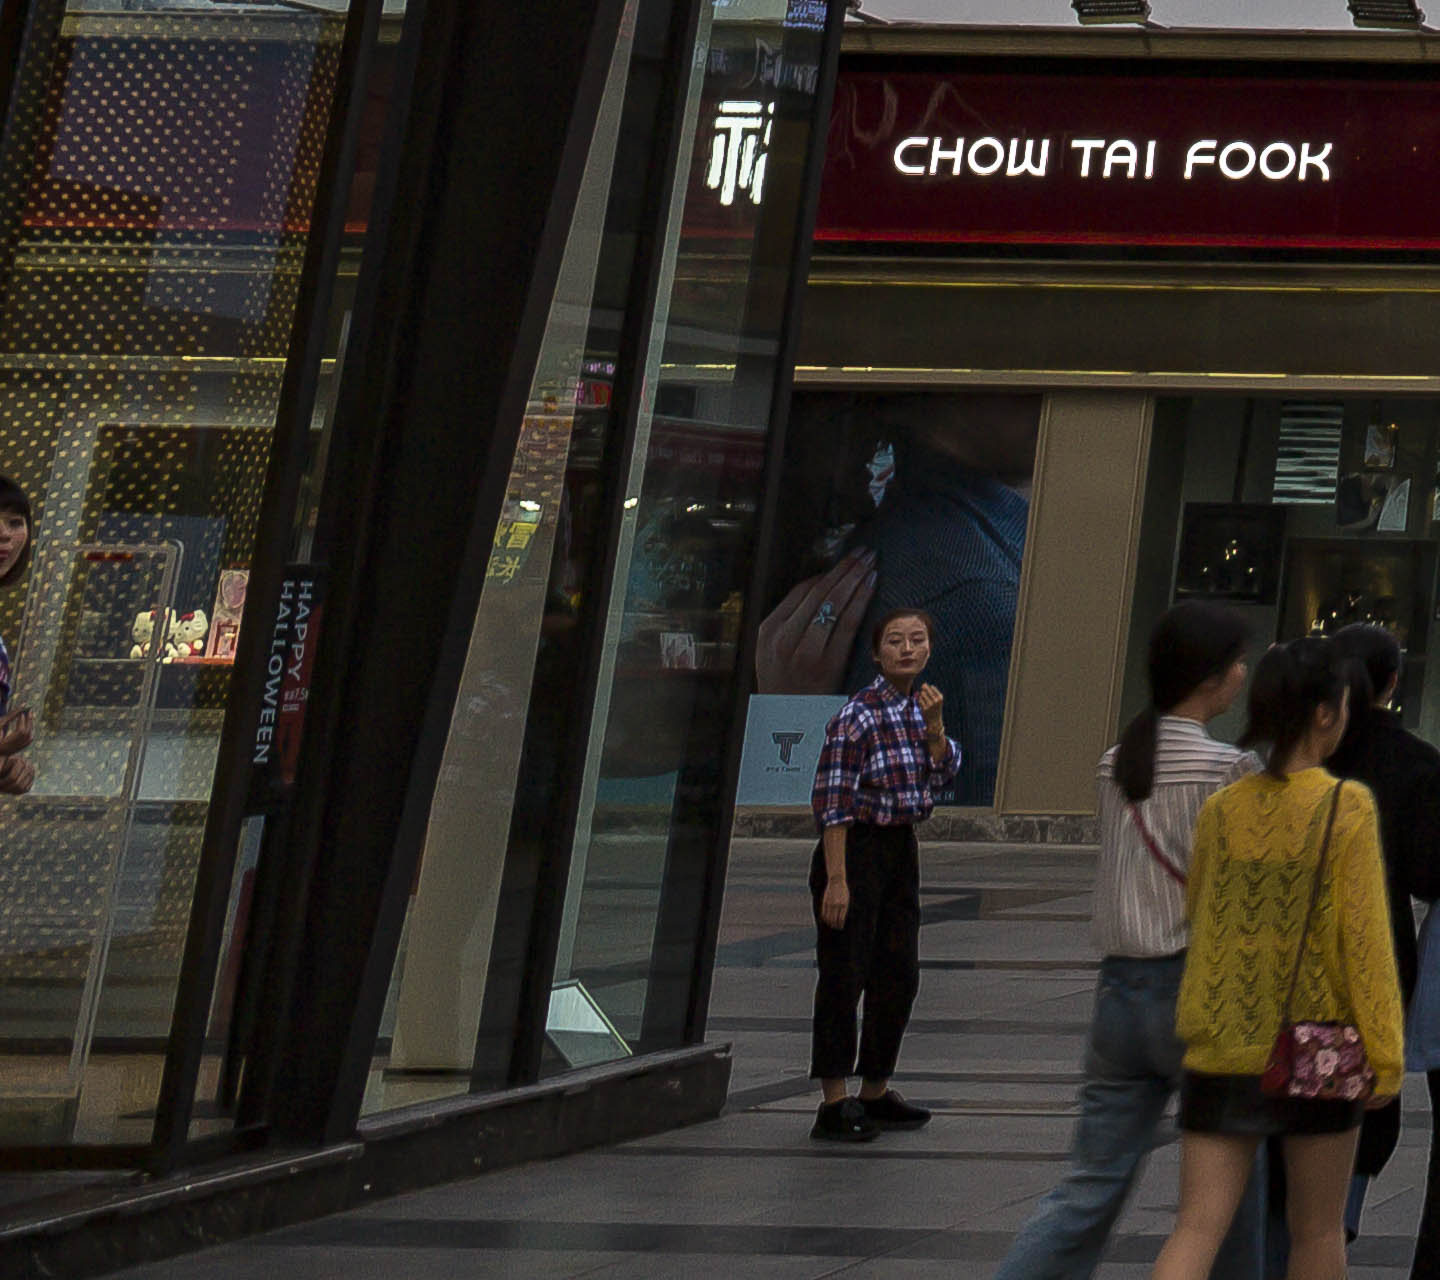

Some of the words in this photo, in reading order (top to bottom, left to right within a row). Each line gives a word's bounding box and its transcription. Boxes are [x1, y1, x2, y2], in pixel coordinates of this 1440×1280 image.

[892, 136, 1051, 178] CHOW
[1070, 138, 1156, 181] TAI
[1182, 140, 1334, 183] FOOK
[252, 580, 296, 765] HALLOWEEN
[287, 580, 314, 682] HAPPY
